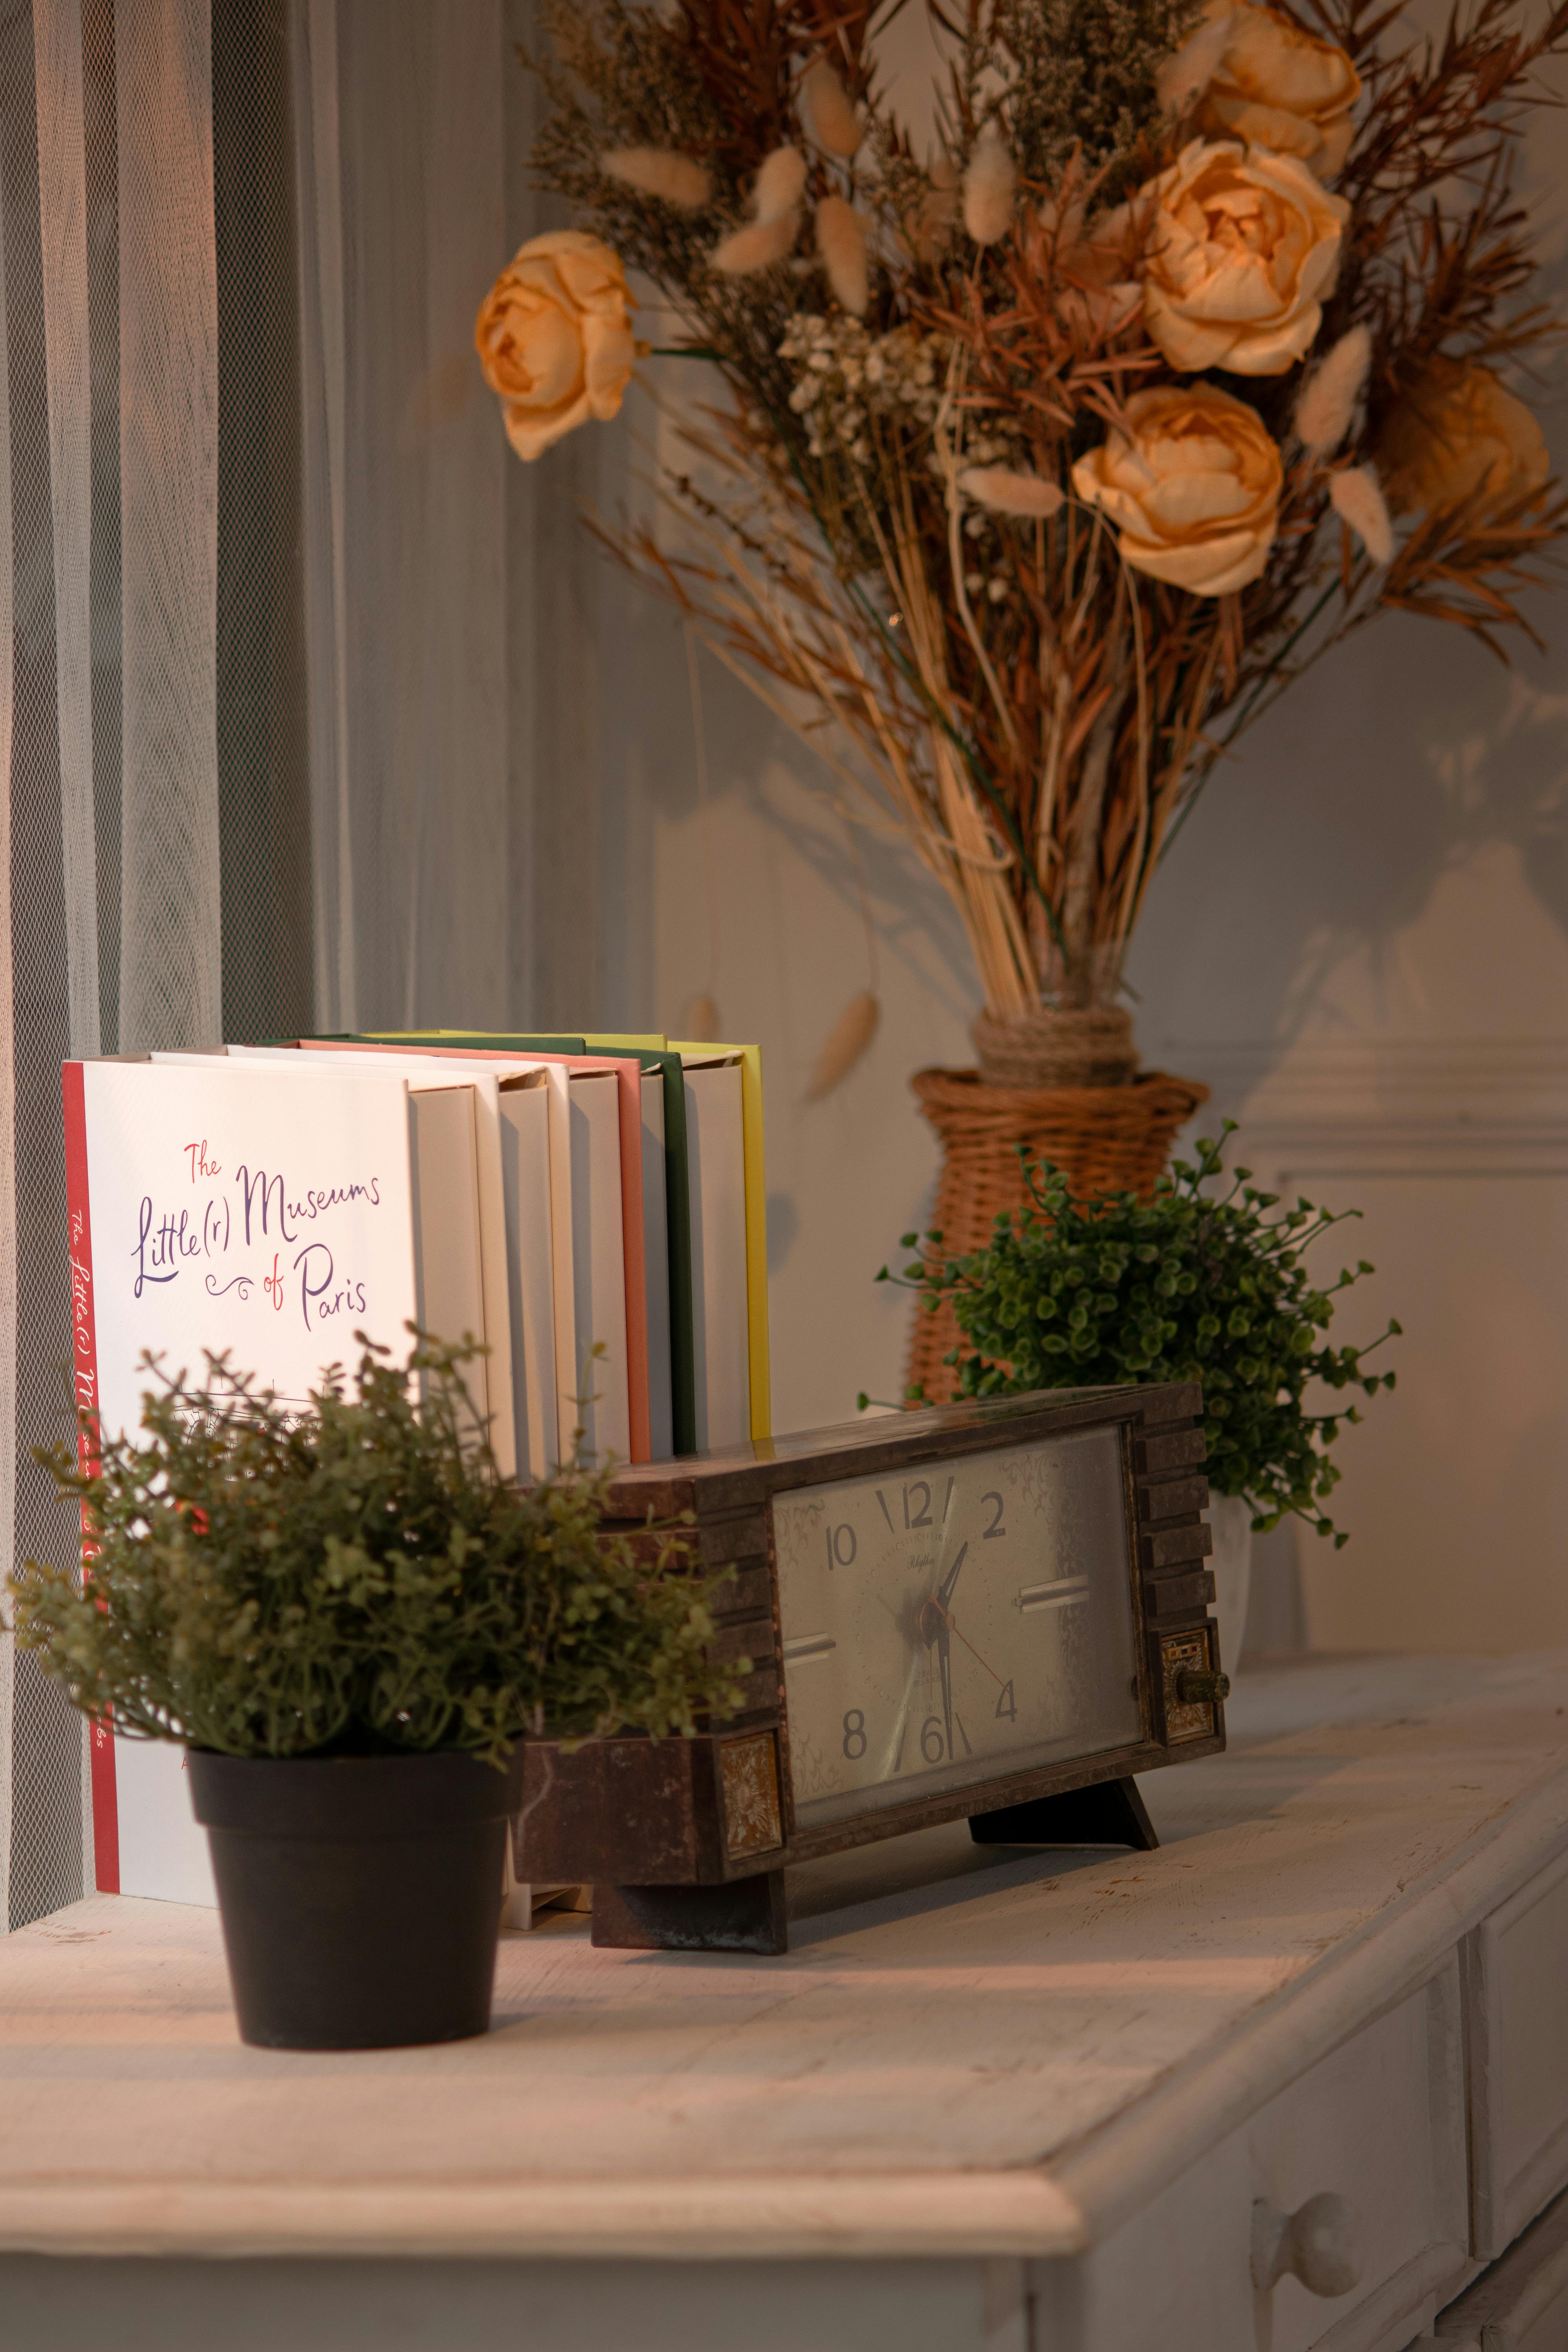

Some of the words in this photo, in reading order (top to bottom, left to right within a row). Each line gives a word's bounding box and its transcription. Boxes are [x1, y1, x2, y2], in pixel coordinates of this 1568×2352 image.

[183, 1139, 222, 1184] The
[72, 1209, 83, 1245] The
[131, 1196, 229, 1299] Little(r)
[235, 1165, 379, 1246] Museums
[69, 1255, 90, 1354] Little(r)
[263, 1253, 284, 1311] of
[293, 1243, 366, 1333] Paris
[902, 1481, 933, 1530] 12
[980, 1491, 1006, 1540] 2
[825, 1523, 857, 1571] 10
[907, 1552, 935, 1573] Rhythm
[994, 1679, 1018, 1724] 4
[843, 1709, 867, 1760] 8
[920, 1716, 945, 1765] 6
